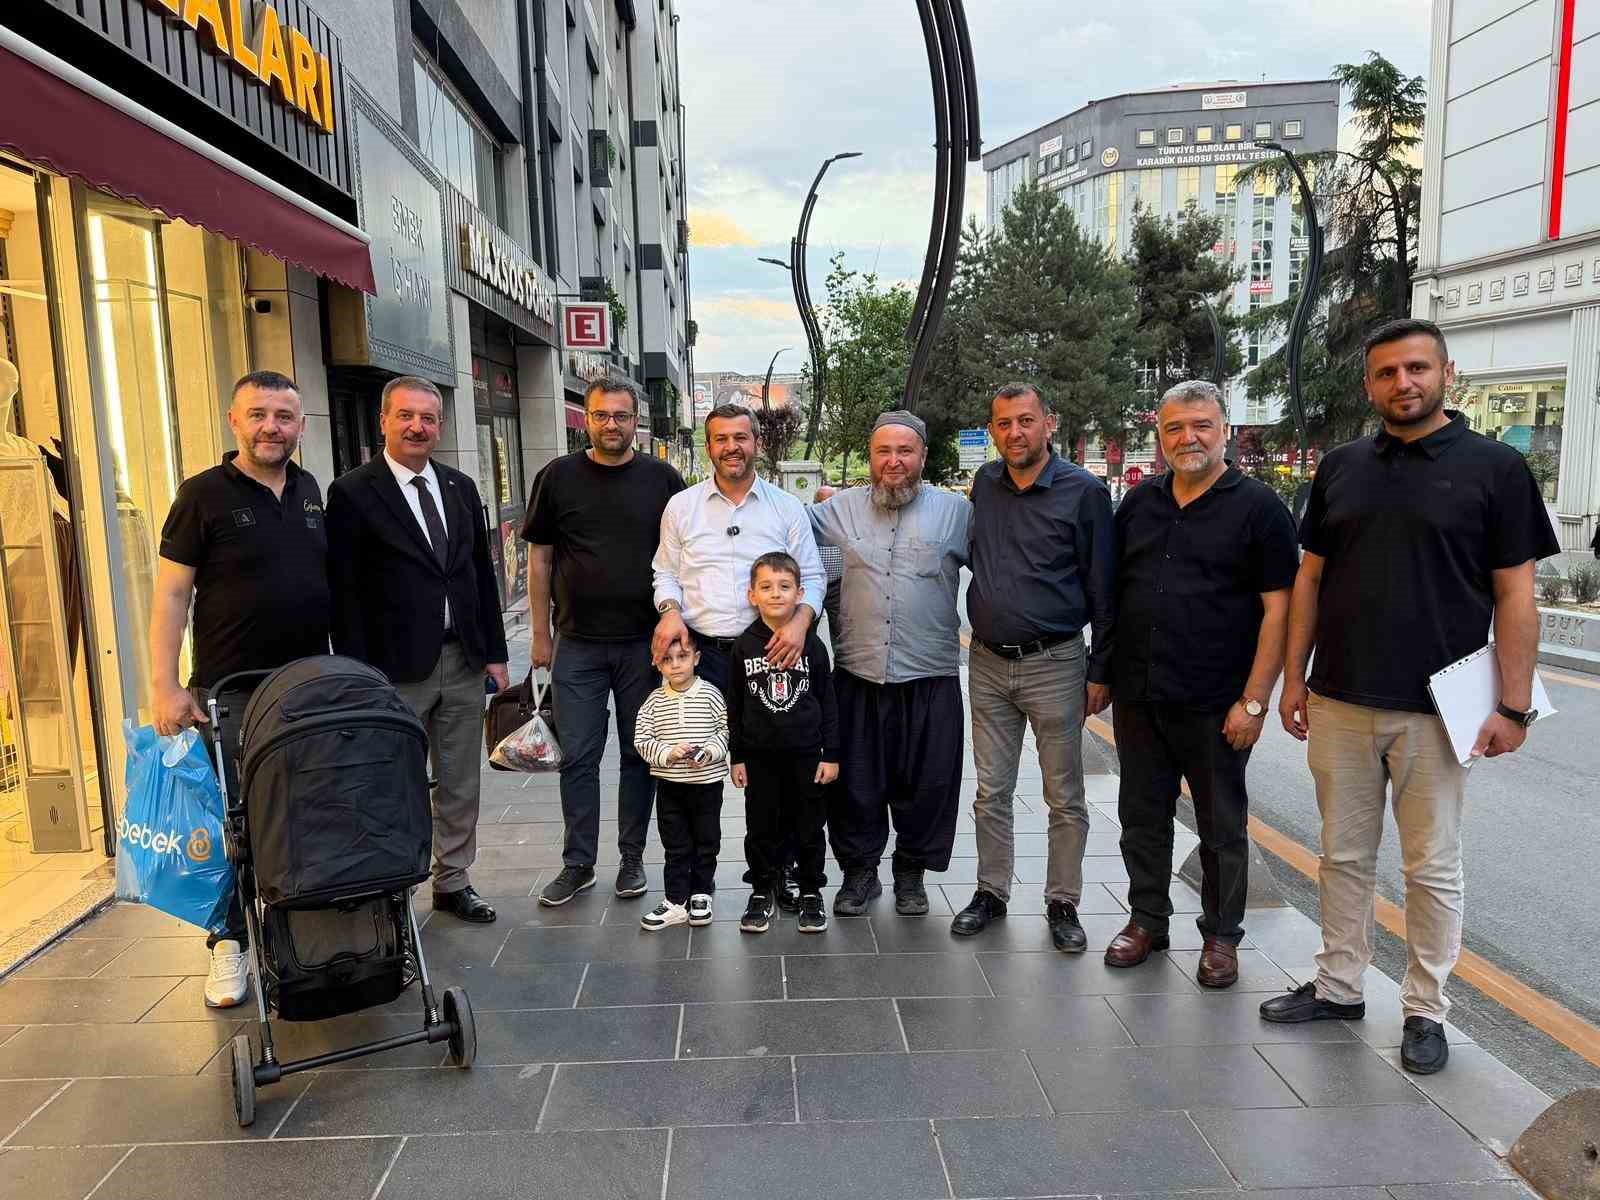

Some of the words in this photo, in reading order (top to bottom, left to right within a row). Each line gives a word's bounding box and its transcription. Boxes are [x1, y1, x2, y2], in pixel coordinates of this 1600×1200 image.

[1158, 144, 1194, 155] TÜRKİYE
[1196, 142, 1236, 153] BAROLAR
[1137, 156, 1176, 166] KARABÜK
[1177, 154, 1212, 164] BAROSU
[1214, 152, 1247, 162] SOSYAL
[391, 194, 425, 253] EMEK
[1125, 472, 1143, 481] DUR
[1538, 614, 1585, 630] BÜK
